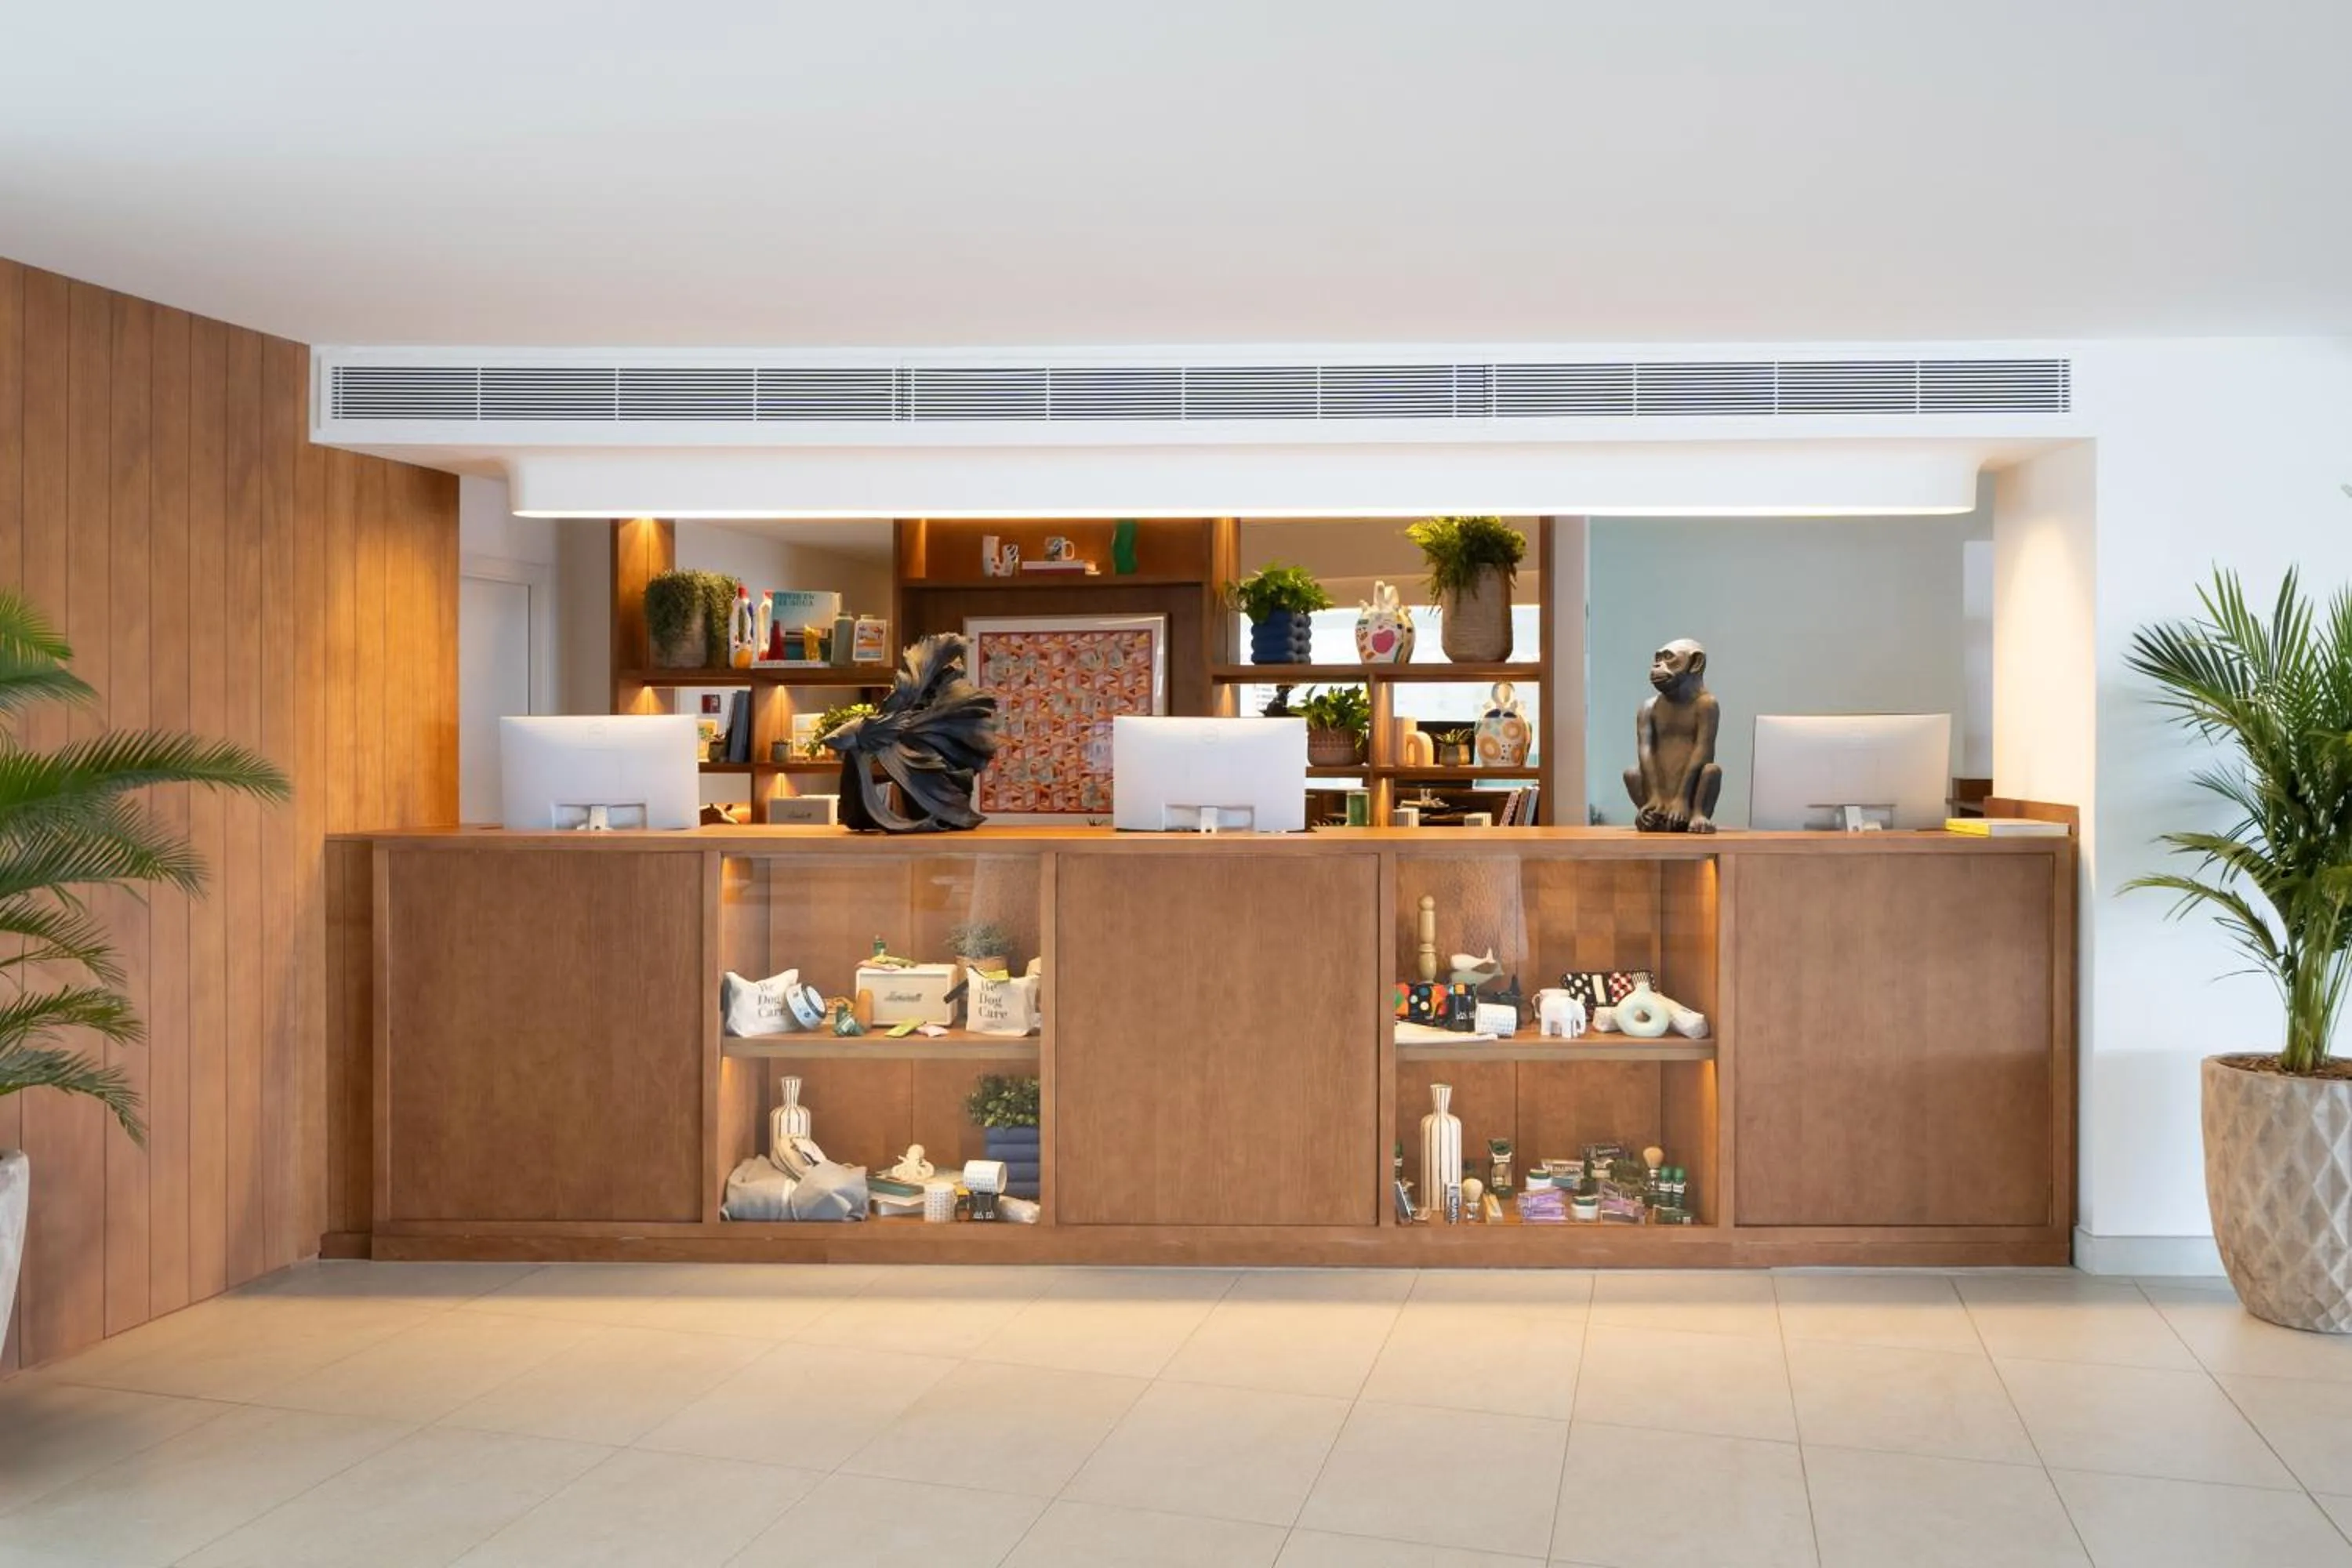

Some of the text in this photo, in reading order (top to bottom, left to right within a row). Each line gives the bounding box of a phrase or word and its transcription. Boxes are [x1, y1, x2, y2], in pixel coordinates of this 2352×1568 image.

[757, 994, 782, 1004] Dog
[978, 993, 1003, 1008] Dog
[978, 1006, 1008, 1018] Care
